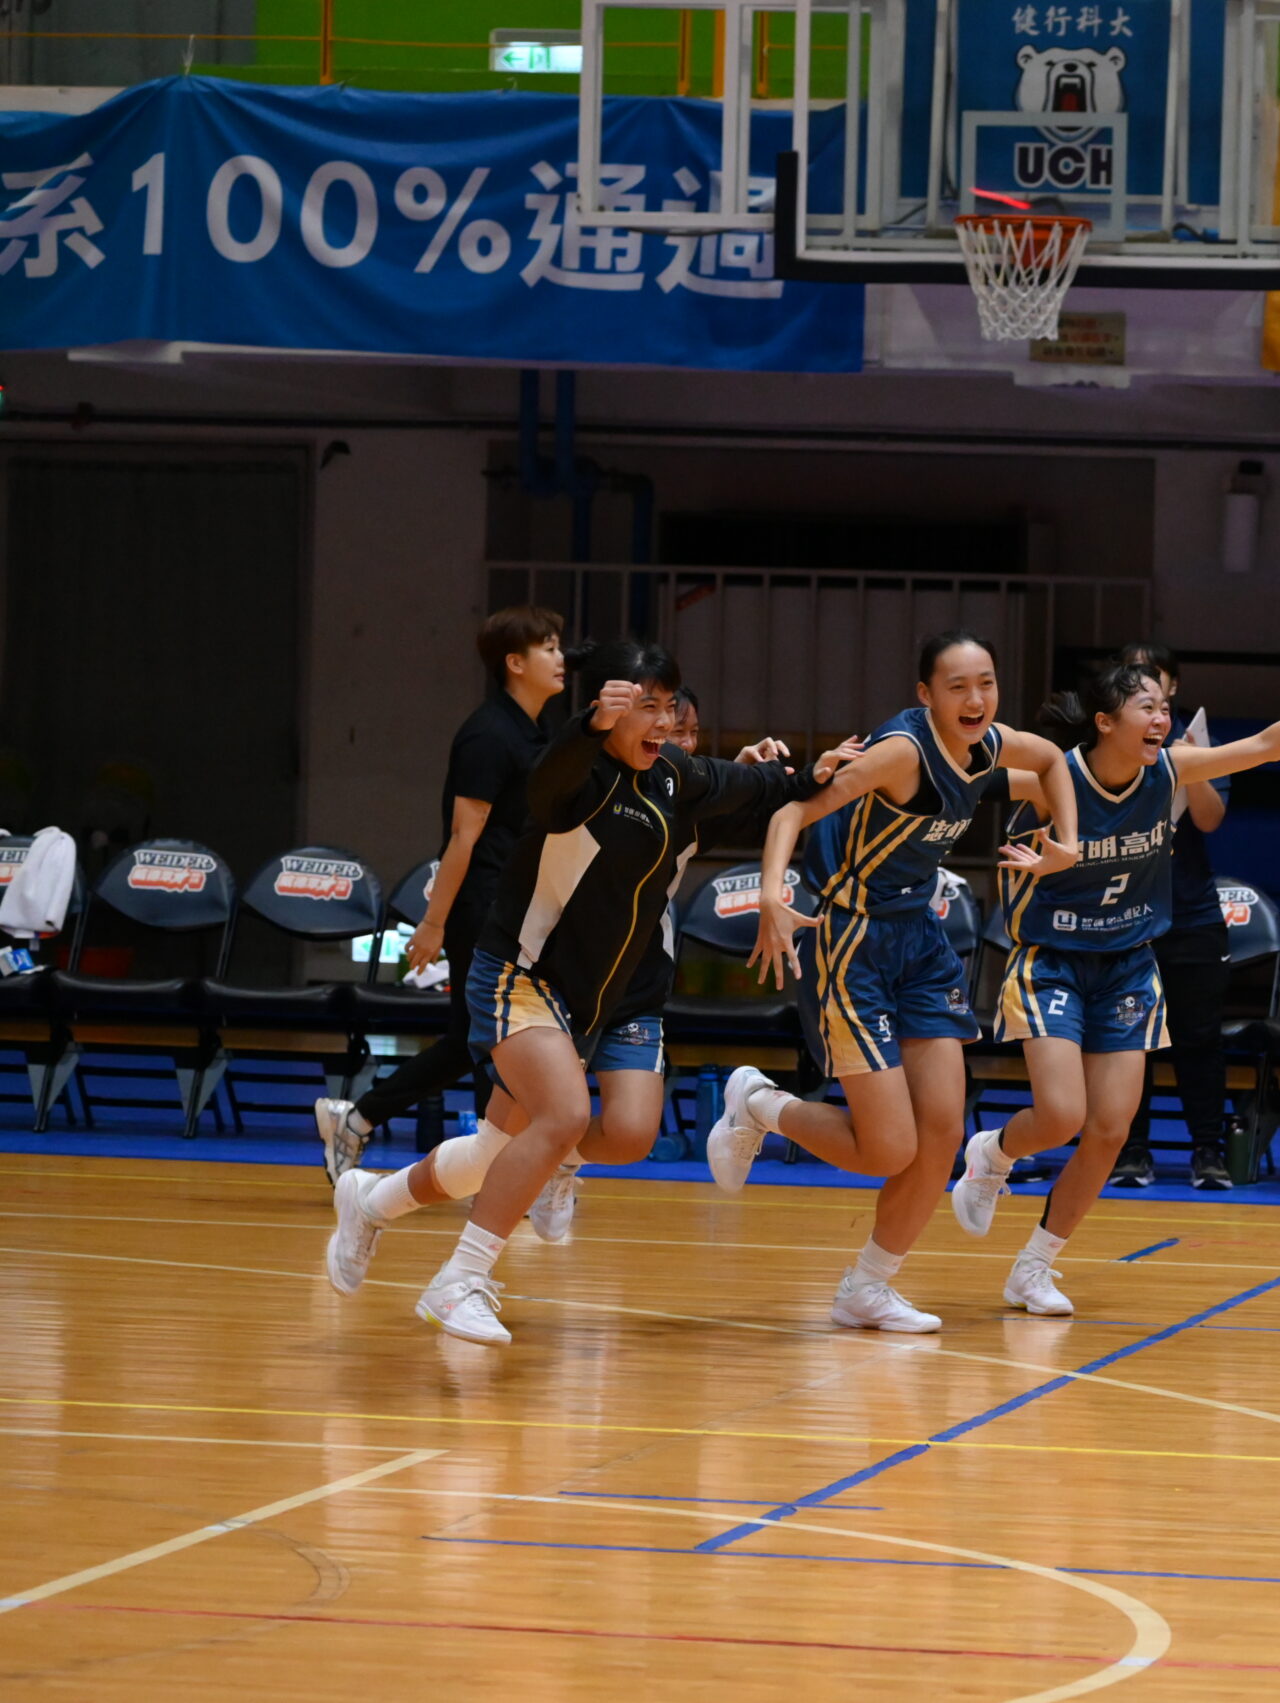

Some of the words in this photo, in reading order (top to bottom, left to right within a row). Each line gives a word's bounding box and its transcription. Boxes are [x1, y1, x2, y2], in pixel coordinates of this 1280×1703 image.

[1012, 4, 1133, 37] 健行科大
[1014, 142, 1114, 189] UCH
[138, 851, 209, 870] WEIDER
[285, 858, 355, 877] WEIDER
[1101, 872, 1131, 906] 2
[1048, 989, 1069, 1015] 2
